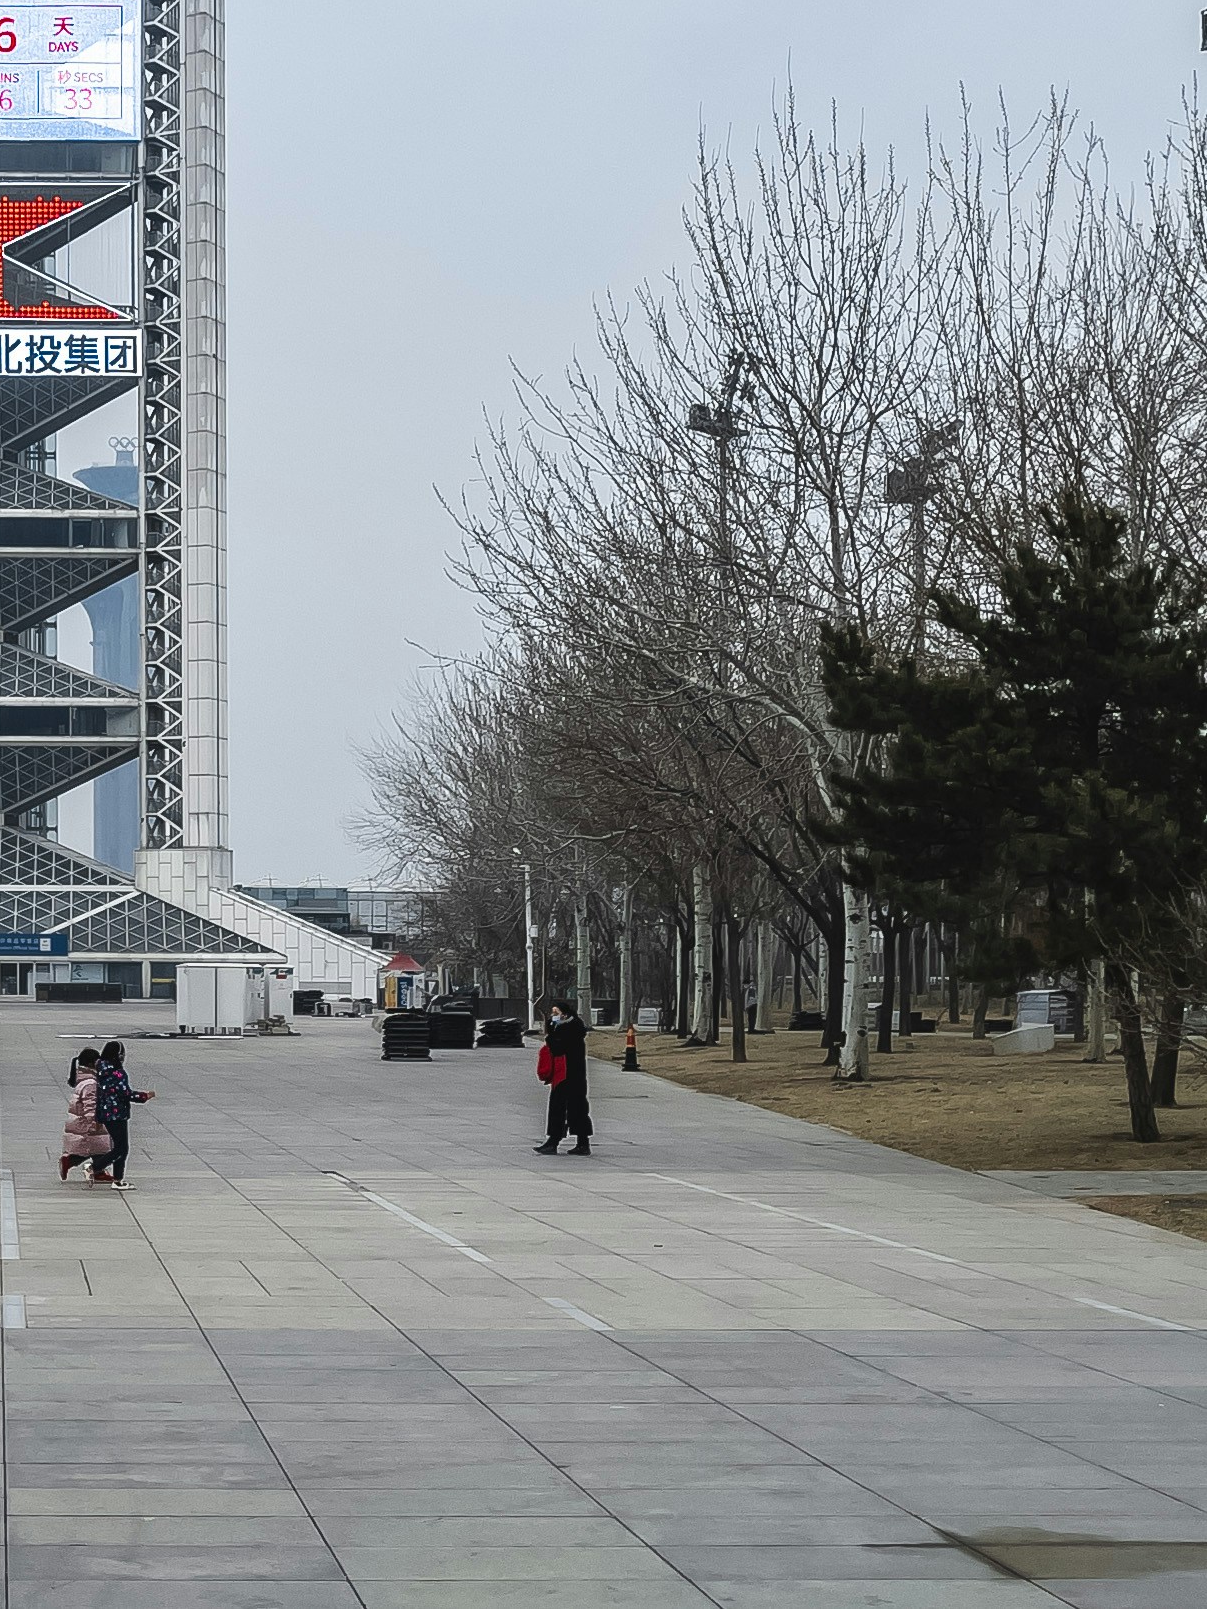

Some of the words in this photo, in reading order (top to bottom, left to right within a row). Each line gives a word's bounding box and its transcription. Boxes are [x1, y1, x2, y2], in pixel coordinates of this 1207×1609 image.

[52, 16, 75, 37] 天
[48, 41, 79, 53] DAYS
[64, 88, 93, 110] 33
